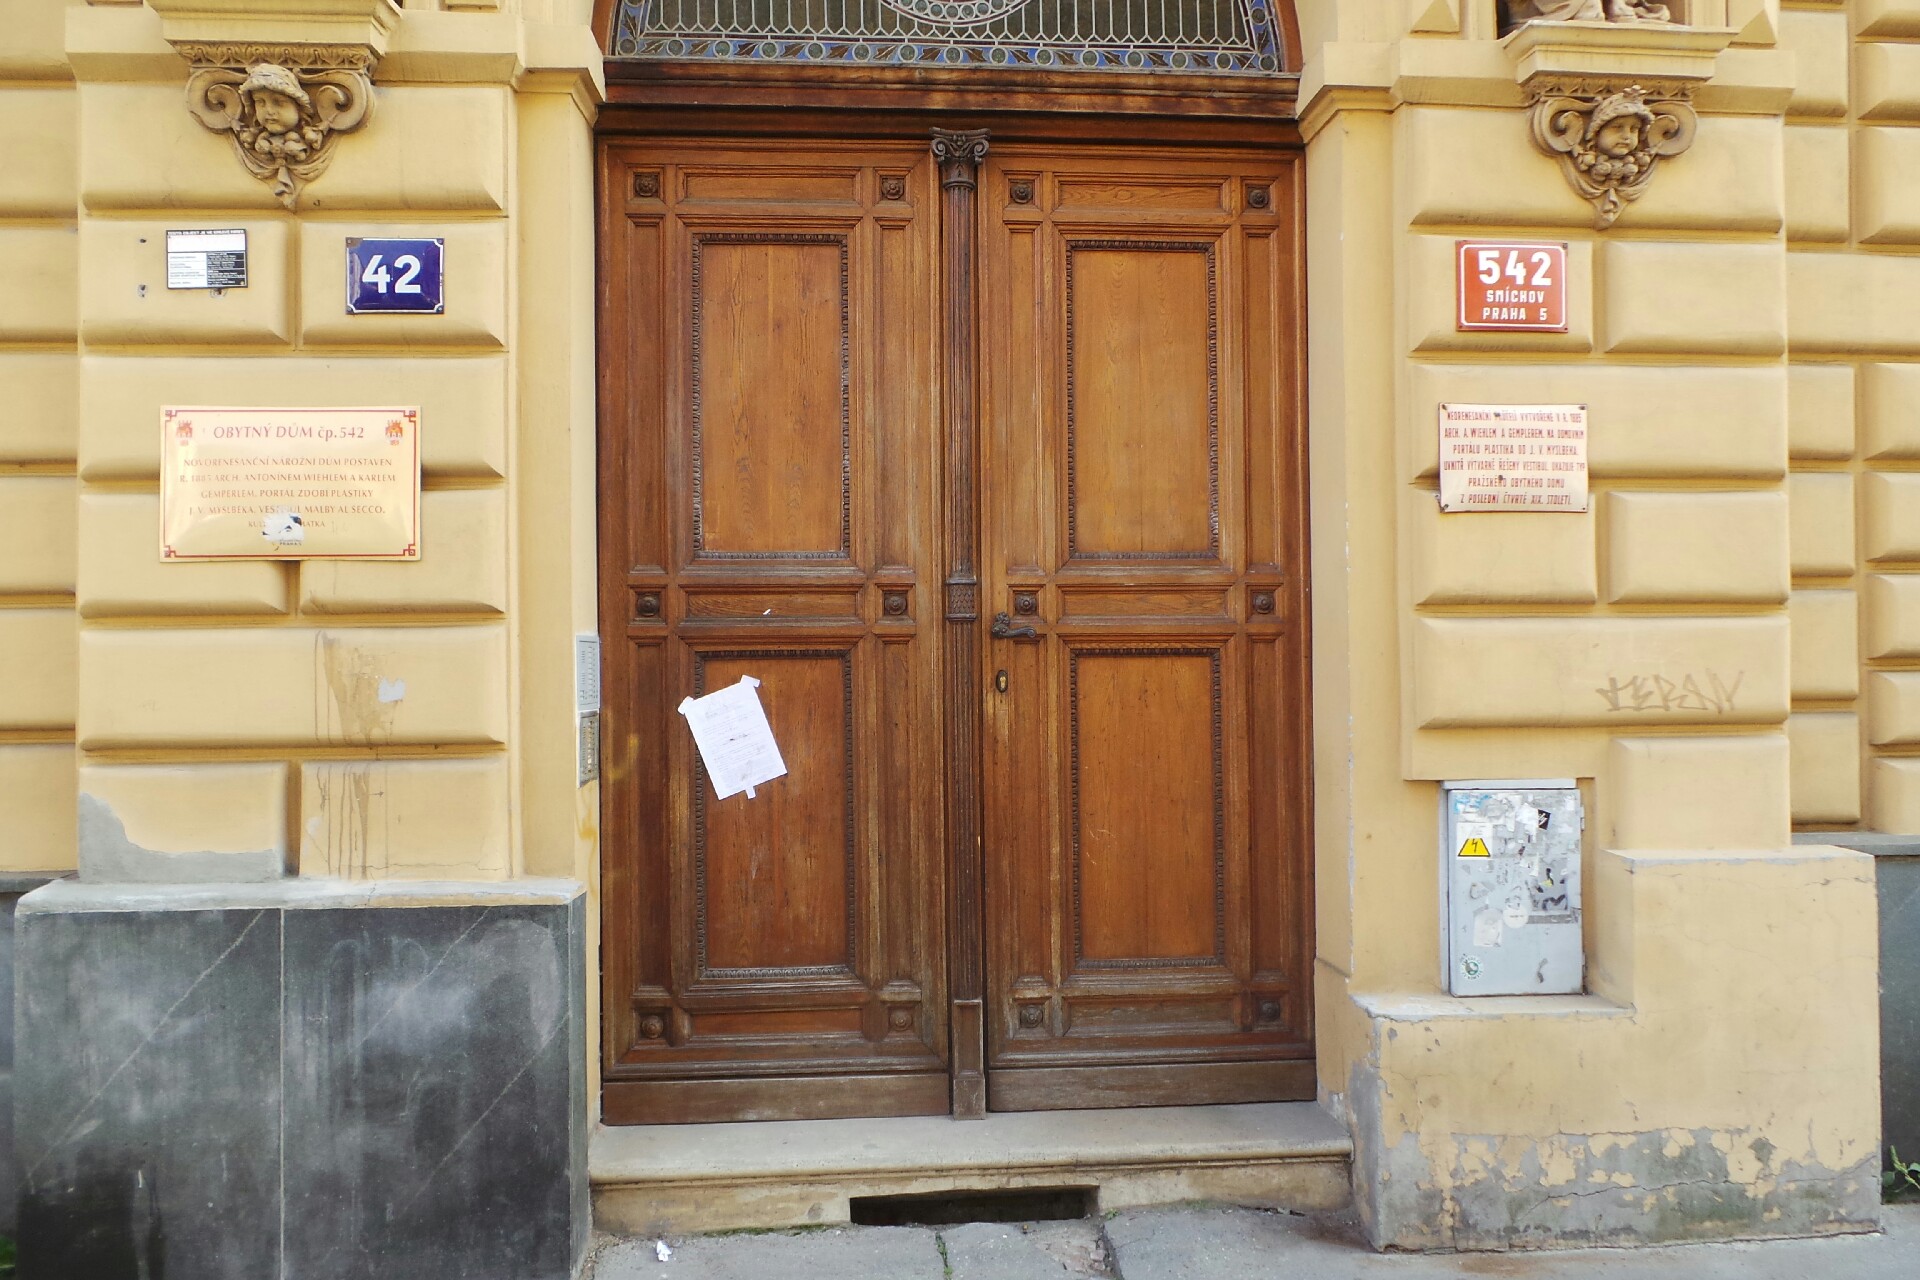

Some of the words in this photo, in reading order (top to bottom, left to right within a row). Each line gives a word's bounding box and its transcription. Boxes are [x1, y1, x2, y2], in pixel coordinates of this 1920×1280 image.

[1478, 250, 1552, 286] 542
[362, 254, 421, 294] 42
[1486, 286, 1545, 303] SMÍCHOV
[1482, 307, 1526, 320] PRAHA
[1539, 307, 1548, 321] 5
[213, 422, 272, 439] OBYTNÝ
[276, 422, 312, 438] DŮM
[1470, 428, 1497, 438] WIEHLEM
[1501, 428, 1505, 438] A
[1547, 429, 1554, 438] NA
[1484, 444, 1514, 454] PLASTIKA
[1518, 444, 1526, 455] OD
[184, 456, 269, 467] NOVORENESANČNÍ
[344, 458, 392, 467] POSTAVEN
[245, 473, 301, 482] ANTONÍNEM
[303, 473, 347, 482] WIEHLEM
[349, 474, 356, 482] A
[358, 474, 396, 482] KARLEM
[1547, 478, 1565, 488] DOMU
[331, 489, 374, 498] PLASTIKY
[304, 506, 336, 514] MALBY
[339, 506, 349, 514] AL
[351, 506, 386, 514] SECCO.
